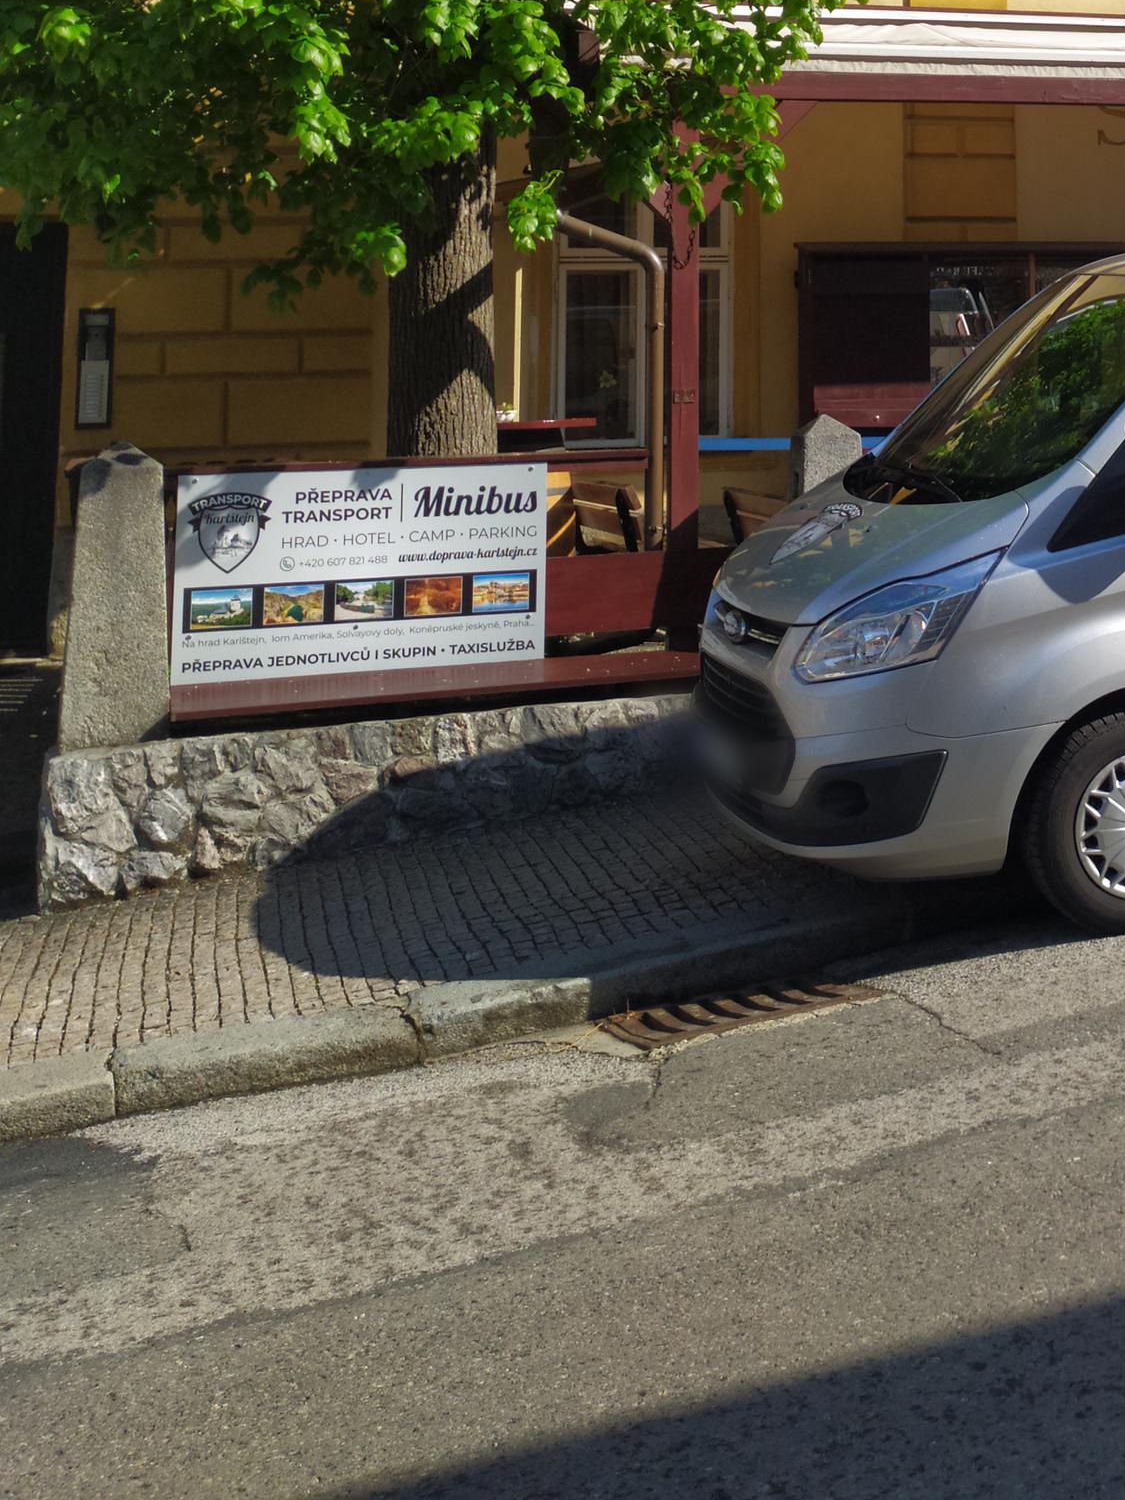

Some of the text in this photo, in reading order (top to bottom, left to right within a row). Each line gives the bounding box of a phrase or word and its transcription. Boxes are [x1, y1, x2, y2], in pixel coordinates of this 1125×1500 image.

[191, 494, 267, 512] TRANSPORT
[295, 487, 392, 504] PŘEPRAVA
[413, 485, 538, 518] Minibus
[282, 506, 393, 524] TRANSPORT
[281, 525, 537, 549] HRAD HOTEL CAMP PARKING
[299, 555, 388, 568] +420 607 821 488
[398, 546, 538, 563] www.doprava-karlstejn.cz
[198, 638, 220, 648] hrad
[181, 638, 536, 674] PŘEPRAVA JEDNOTLIVCŮ I SKUPIN TAXISLUŽBA
